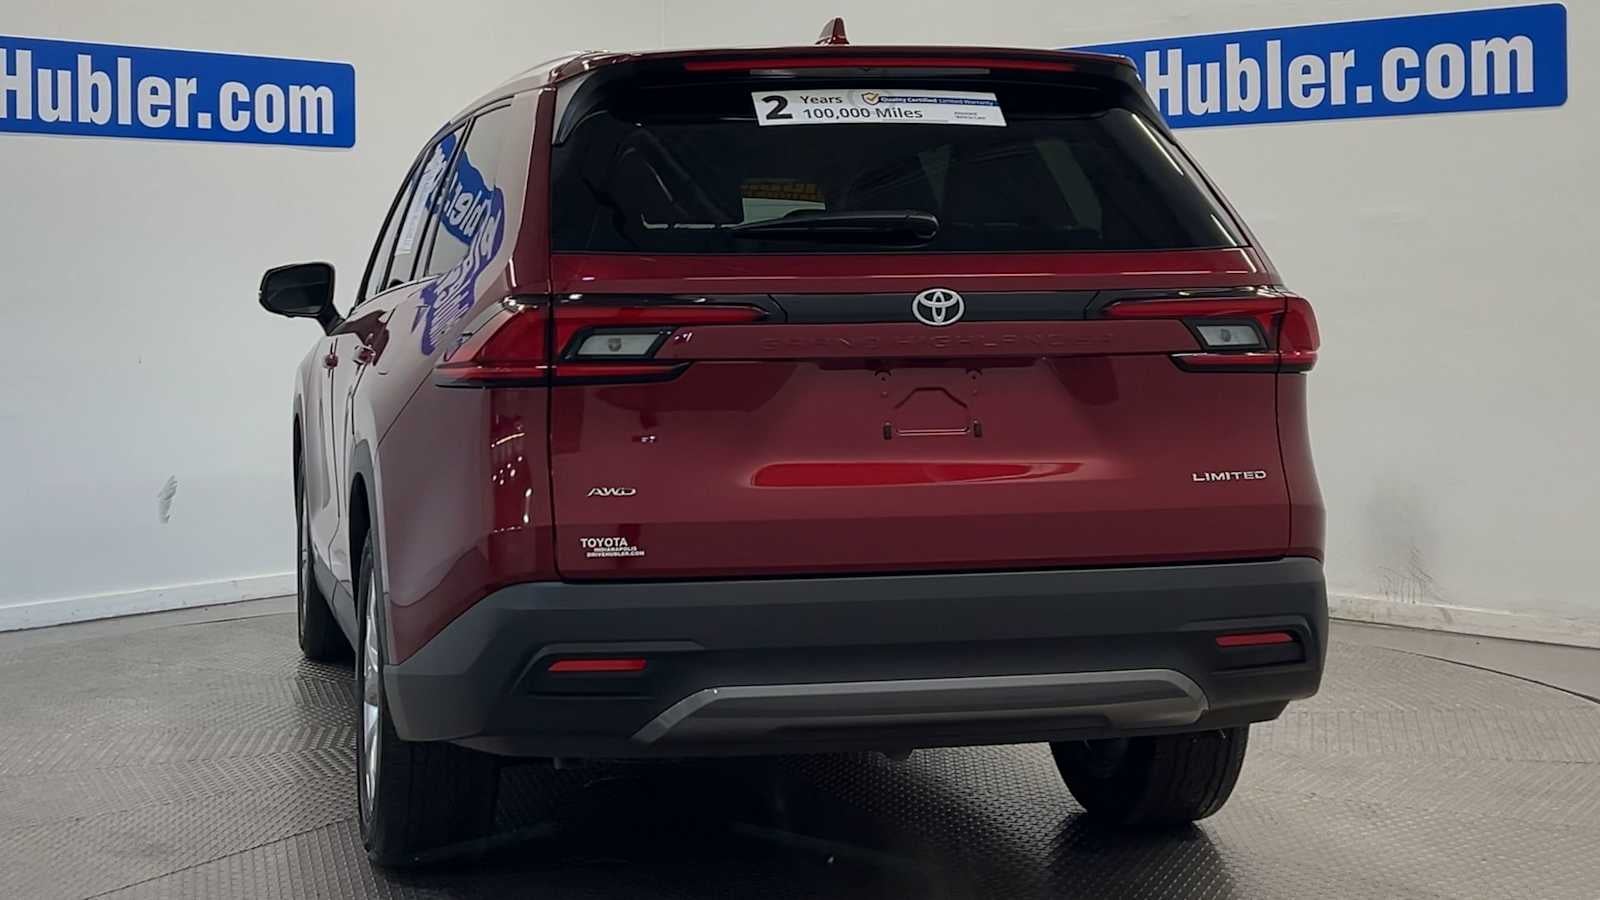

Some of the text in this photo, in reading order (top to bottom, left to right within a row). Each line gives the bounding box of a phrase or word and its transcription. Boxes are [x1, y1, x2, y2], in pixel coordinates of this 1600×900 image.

[1145, 35, 1533, 115] Hubler.com
[0, 48, 334, 134] Hubler.com
[800, 95, 843, 104] Years
[761, 95, 793, 120] 2
[803, 107, 923, 119] 100,000 Miles
[1192, 470, 1266, 481] LIMITED
[587, 487, 636, 497] AWD
[580, 537, 628, 548] TOYOTA
